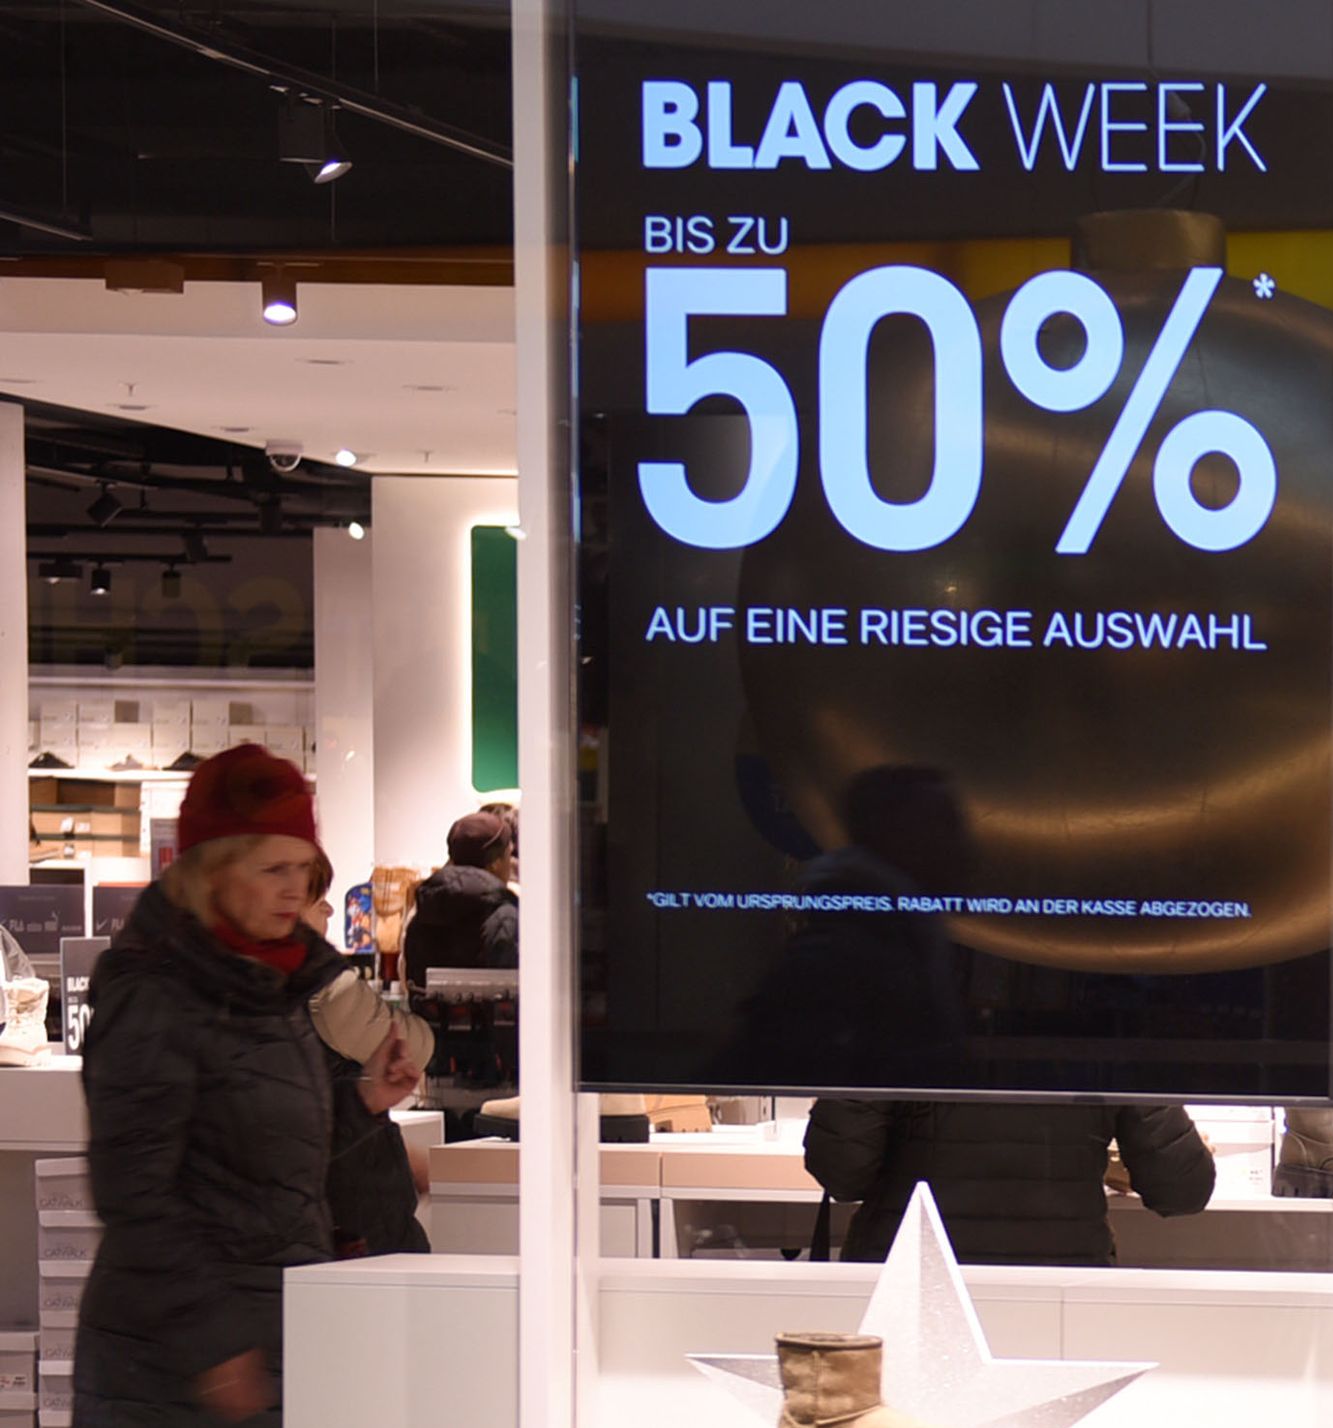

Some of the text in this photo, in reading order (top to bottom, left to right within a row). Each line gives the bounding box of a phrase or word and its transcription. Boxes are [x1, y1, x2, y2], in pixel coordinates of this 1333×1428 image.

[643, 81, 1268, 172] BLACK WEEK
[645, 216, 789, 255] BIS ZU
[645, 606, 1268, 650] AUF EINE RIESIGE AUSWAHL
[693, 893, 735, 909] VOM
[736, 893, 893, 912] URSPRUNGSPREIS.
[897, 896, 964, 912] RABATT
[966, 898, 1013, 914] WIRD
[1014, 899, 1040, 914] AN
[1042, 899, 1079, 915] DER
[1081, 899, 1138, 916] KASSE
